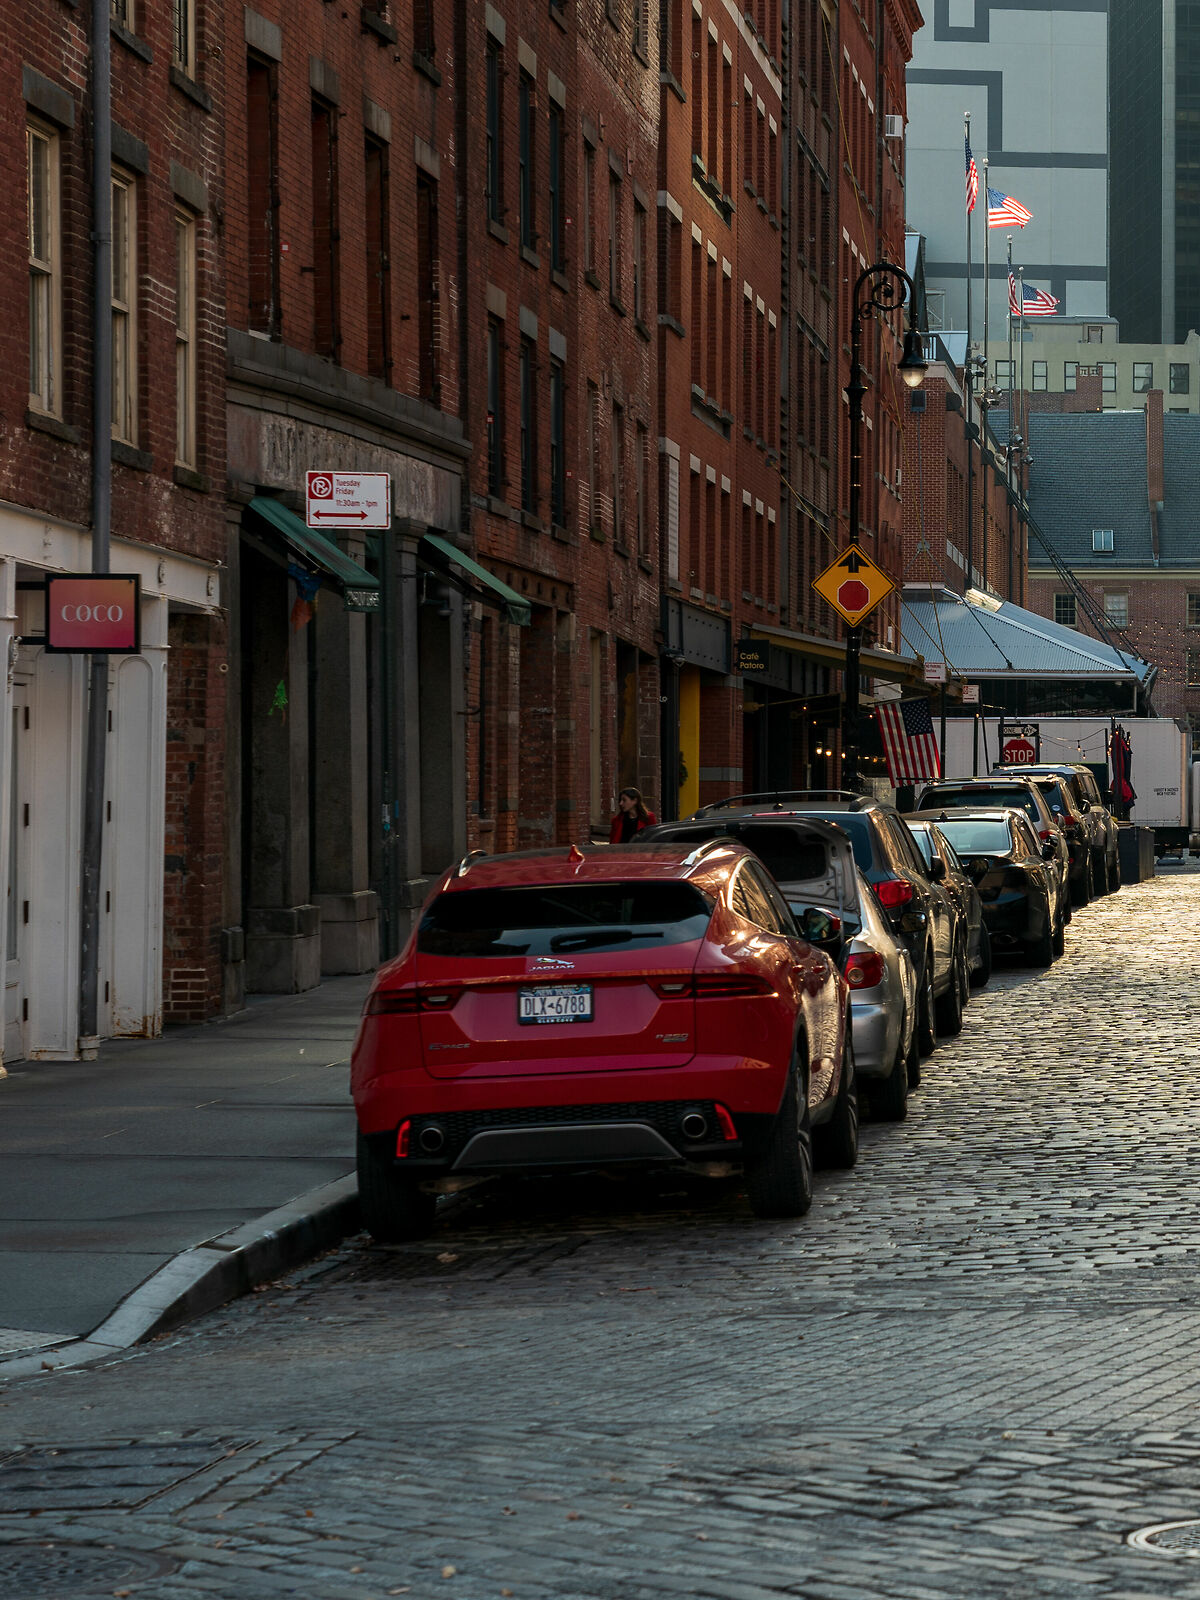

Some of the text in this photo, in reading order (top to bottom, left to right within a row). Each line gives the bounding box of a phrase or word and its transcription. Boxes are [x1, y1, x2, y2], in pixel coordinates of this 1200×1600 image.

[336, 479, 361, 487] Tuesday
[336, 488, 354, 496] Friday
[61, 604, 124, 622] COCO
[740, 661, 765, 669] Patoro
[1003, 749, 1034, 762] STOP
[525, 995, 586, 1016] DLX 6788
